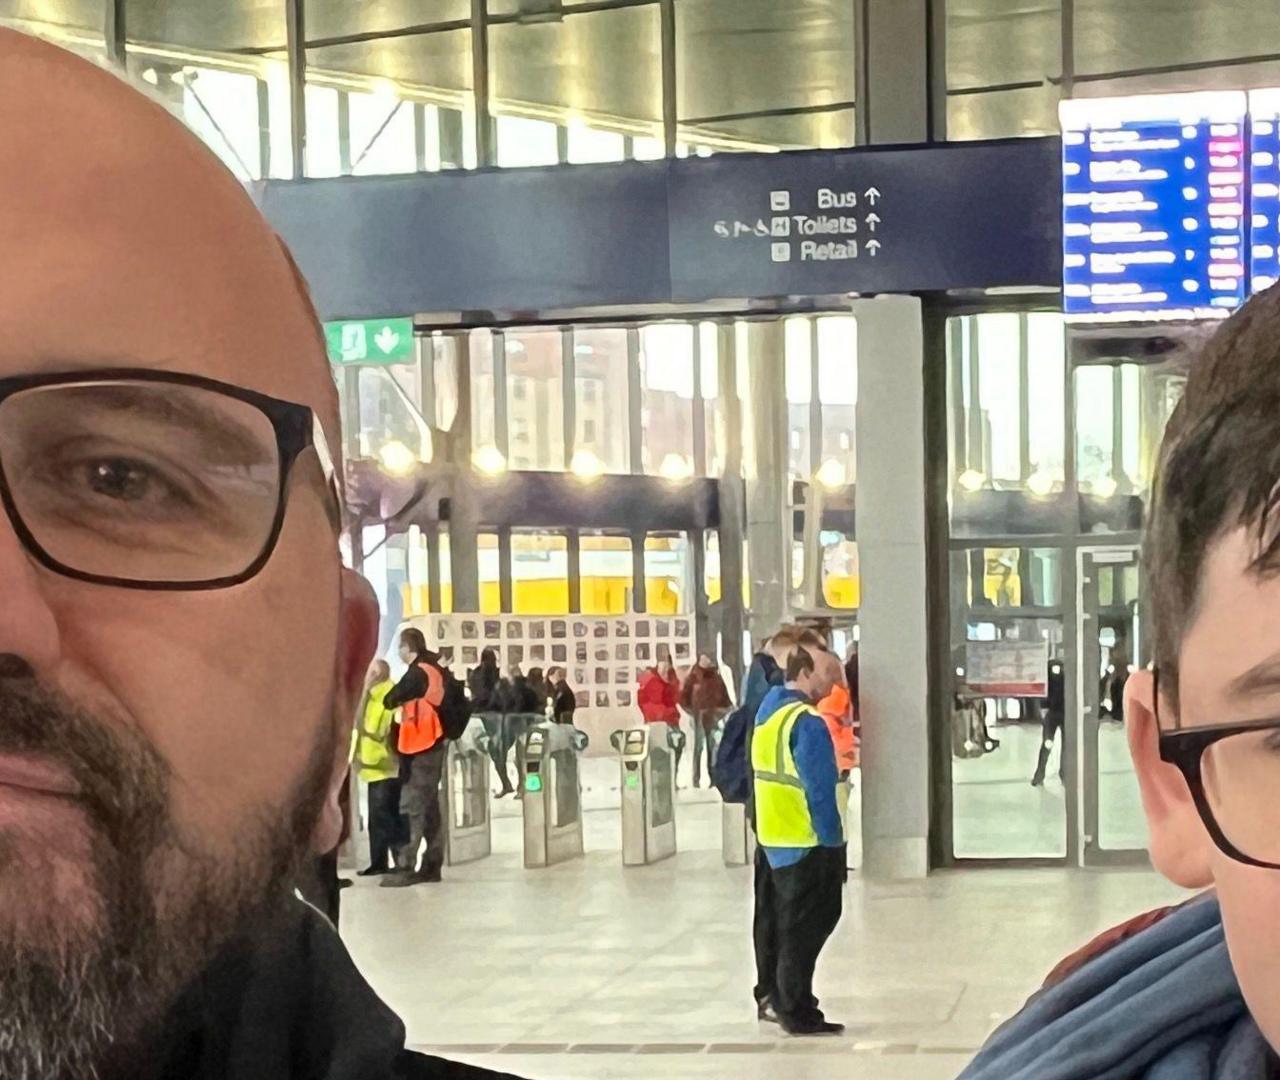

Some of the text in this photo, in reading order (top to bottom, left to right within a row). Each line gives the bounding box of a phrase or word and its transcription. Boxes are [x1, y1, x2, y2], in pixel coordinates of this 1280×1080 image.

[818, 188, 857, 208] Bus
[793, 215, 857, 235] Toilets
[800, 239, 858, 260] Retail
